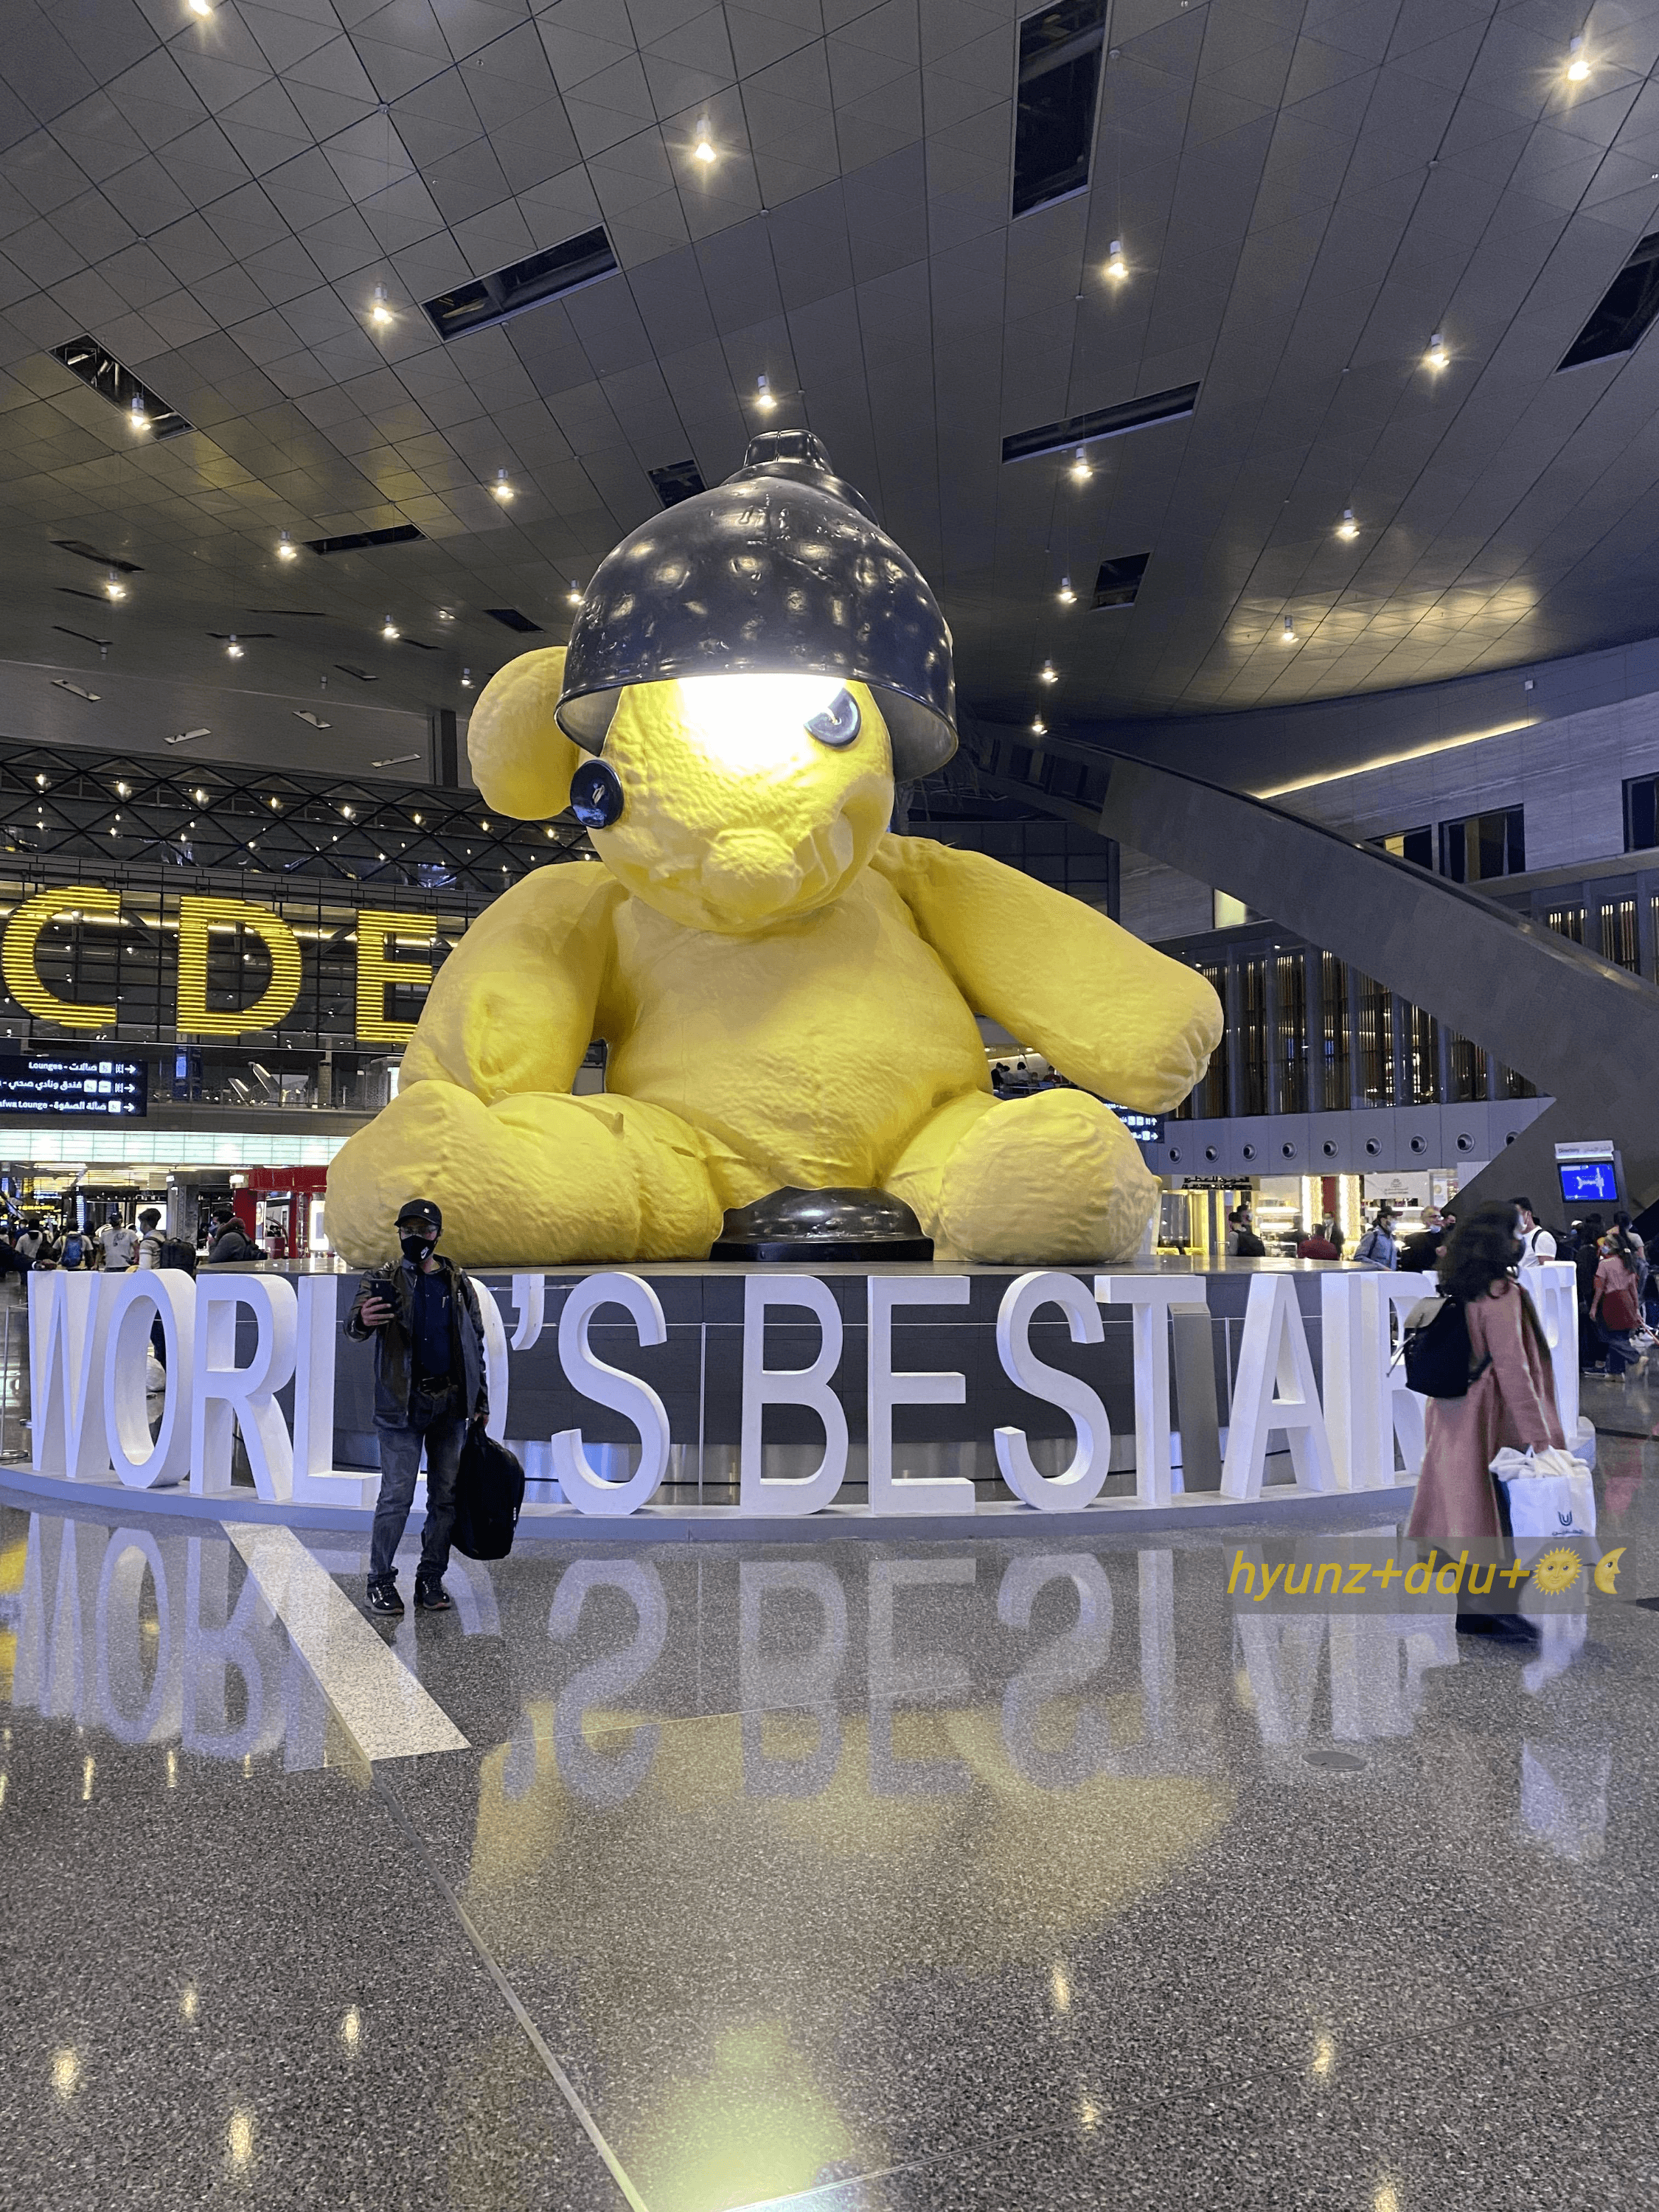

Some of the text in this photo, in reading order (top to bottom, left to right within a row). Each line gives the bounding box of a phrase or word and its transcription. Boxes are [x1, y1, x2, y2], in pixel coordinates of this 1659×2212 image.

[1, 885, 437, 1043] C D E
[28, 1062, 63, 1071] Lounges
[35, 1079, 59, 1091] ونادي
[60, 1081, 83, 1091] فندق
[18, 1100, 48, 1110] Lounge
[740, 1271, 1208, 1516] BEST
